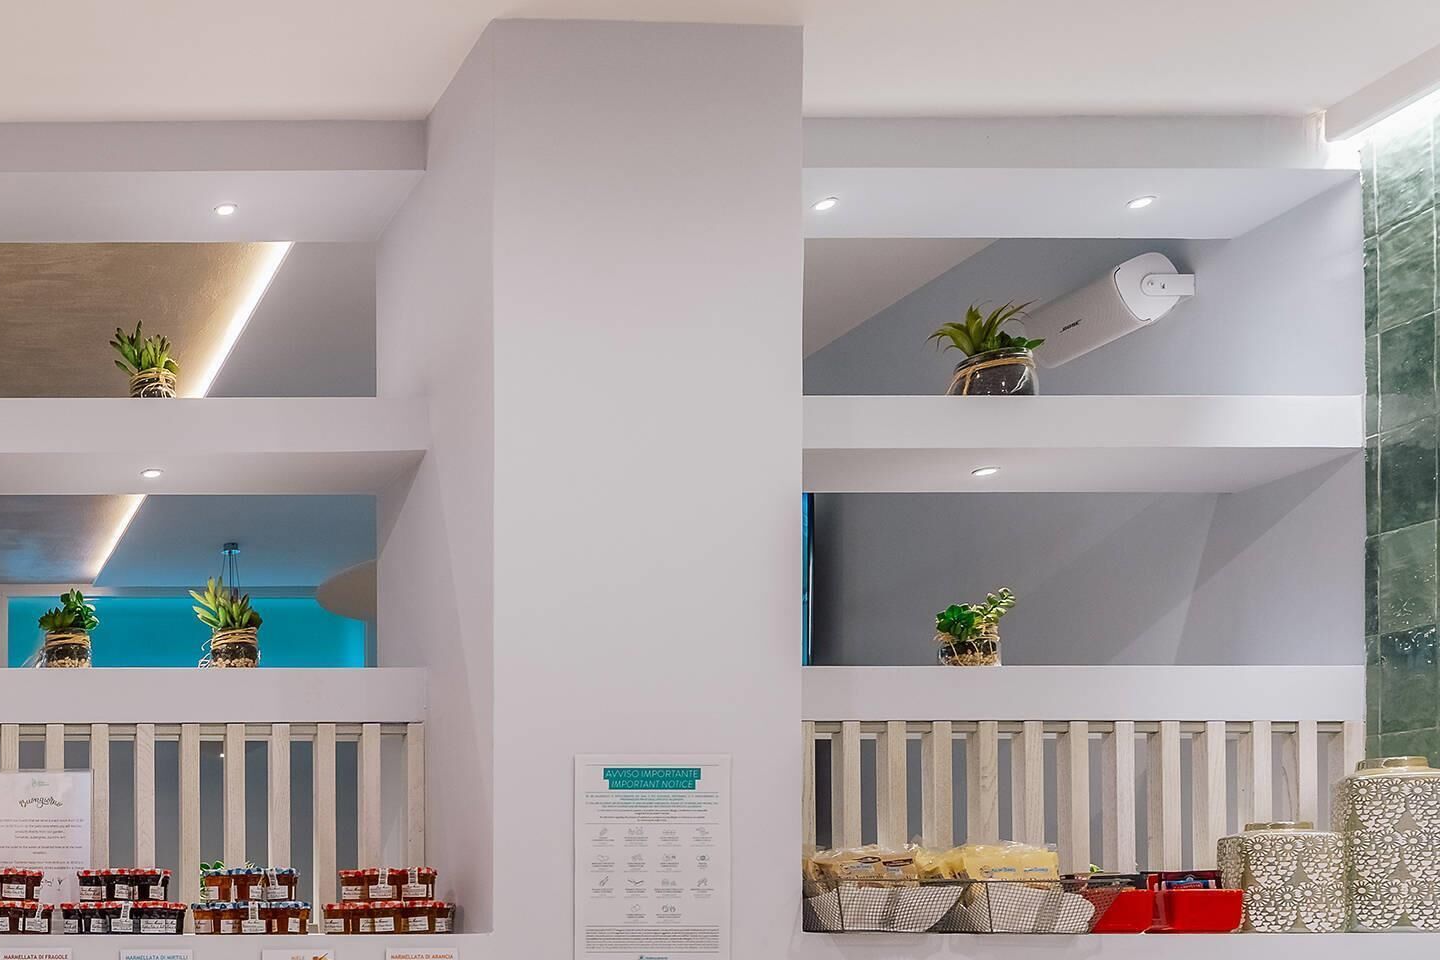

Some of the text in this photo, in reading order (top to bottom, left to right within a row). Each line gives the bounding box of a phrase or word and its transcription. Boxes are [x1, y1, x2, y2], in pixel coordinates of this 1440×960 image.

[605, 770, 698, 778] AVVISO IMPORTANTE
[611, 780, 693, 788] IMPORTANT NOTICE
